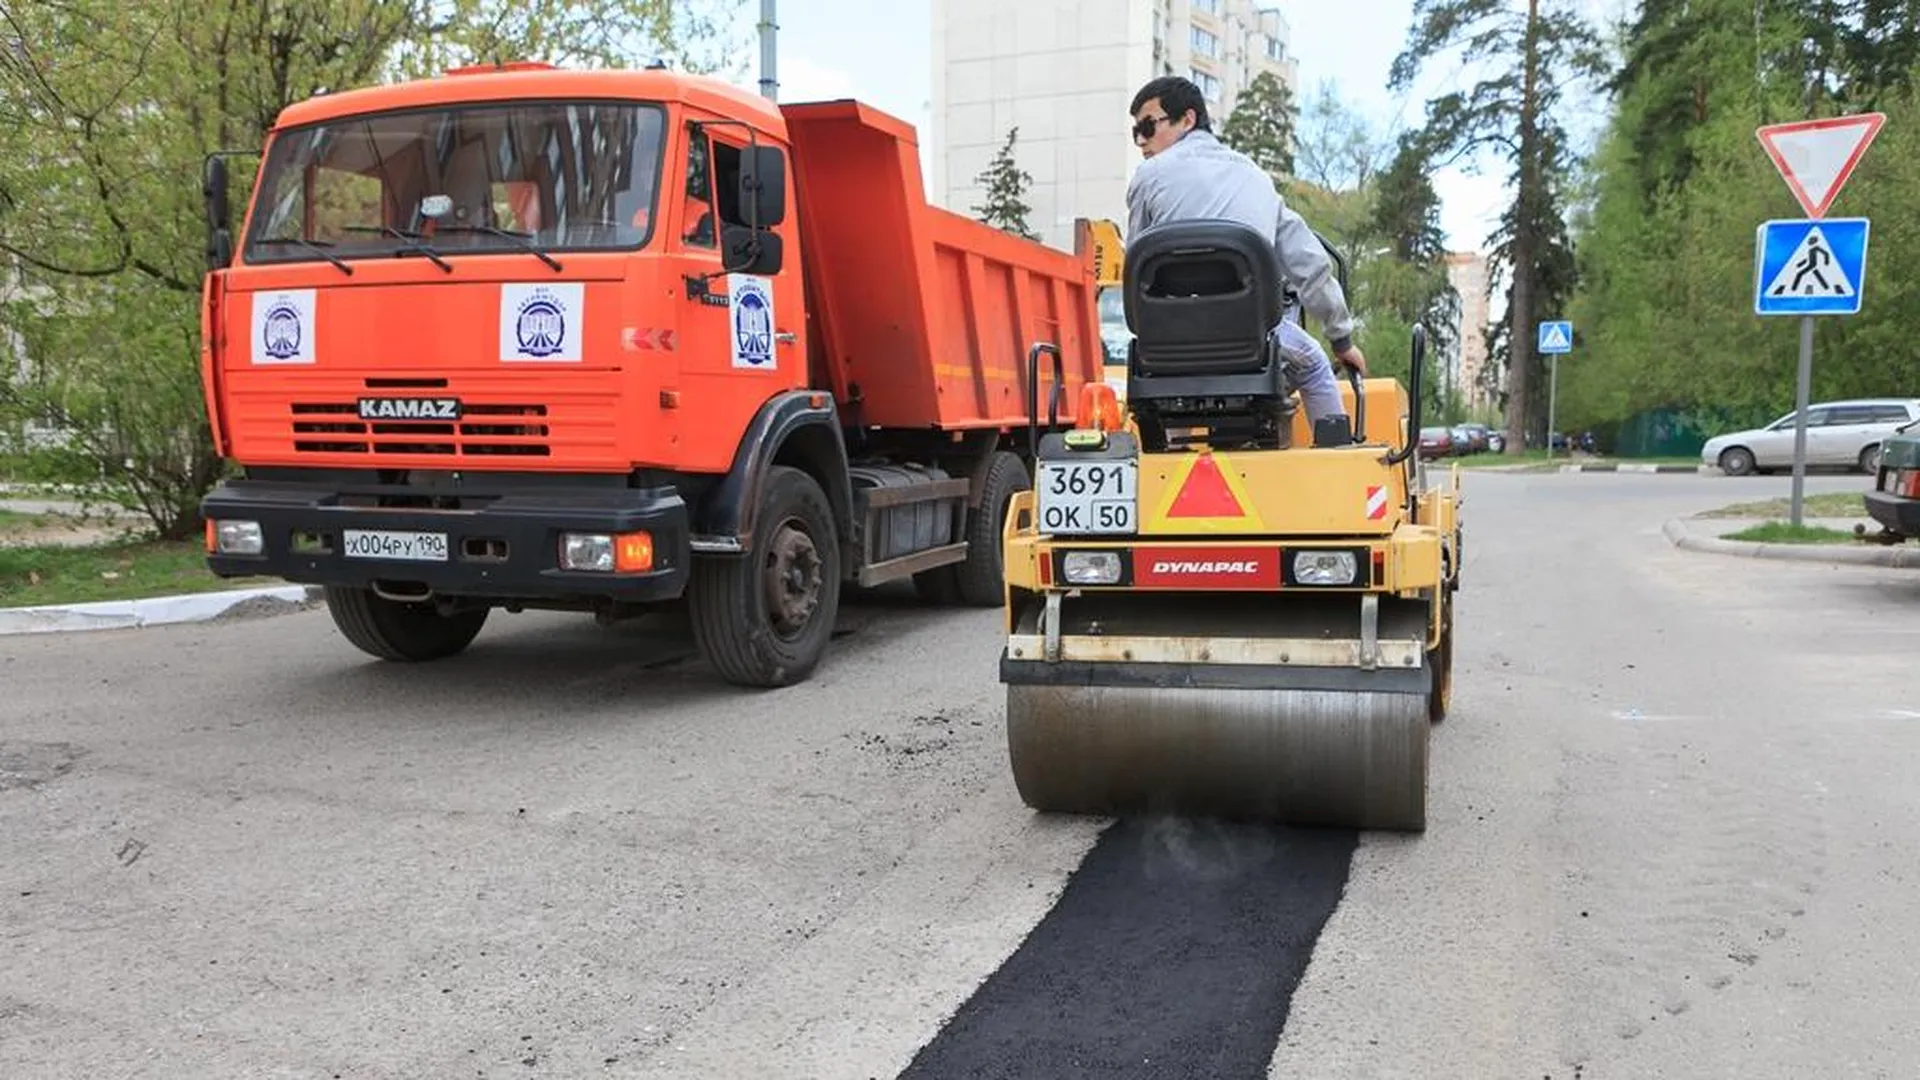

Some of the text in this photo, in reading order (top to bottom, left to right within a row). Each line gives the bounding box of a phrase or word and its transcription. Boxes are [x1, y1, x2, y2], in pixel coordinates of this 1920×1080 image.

[360, 399, 457, 418] KAMAZ
[1050, 466, 1123, 495] 3691
[1100, 505, 1128, 528] 50
[417, 535, 442, 552] 190
[1152, 561, 1259, 573] DYNAPAC
